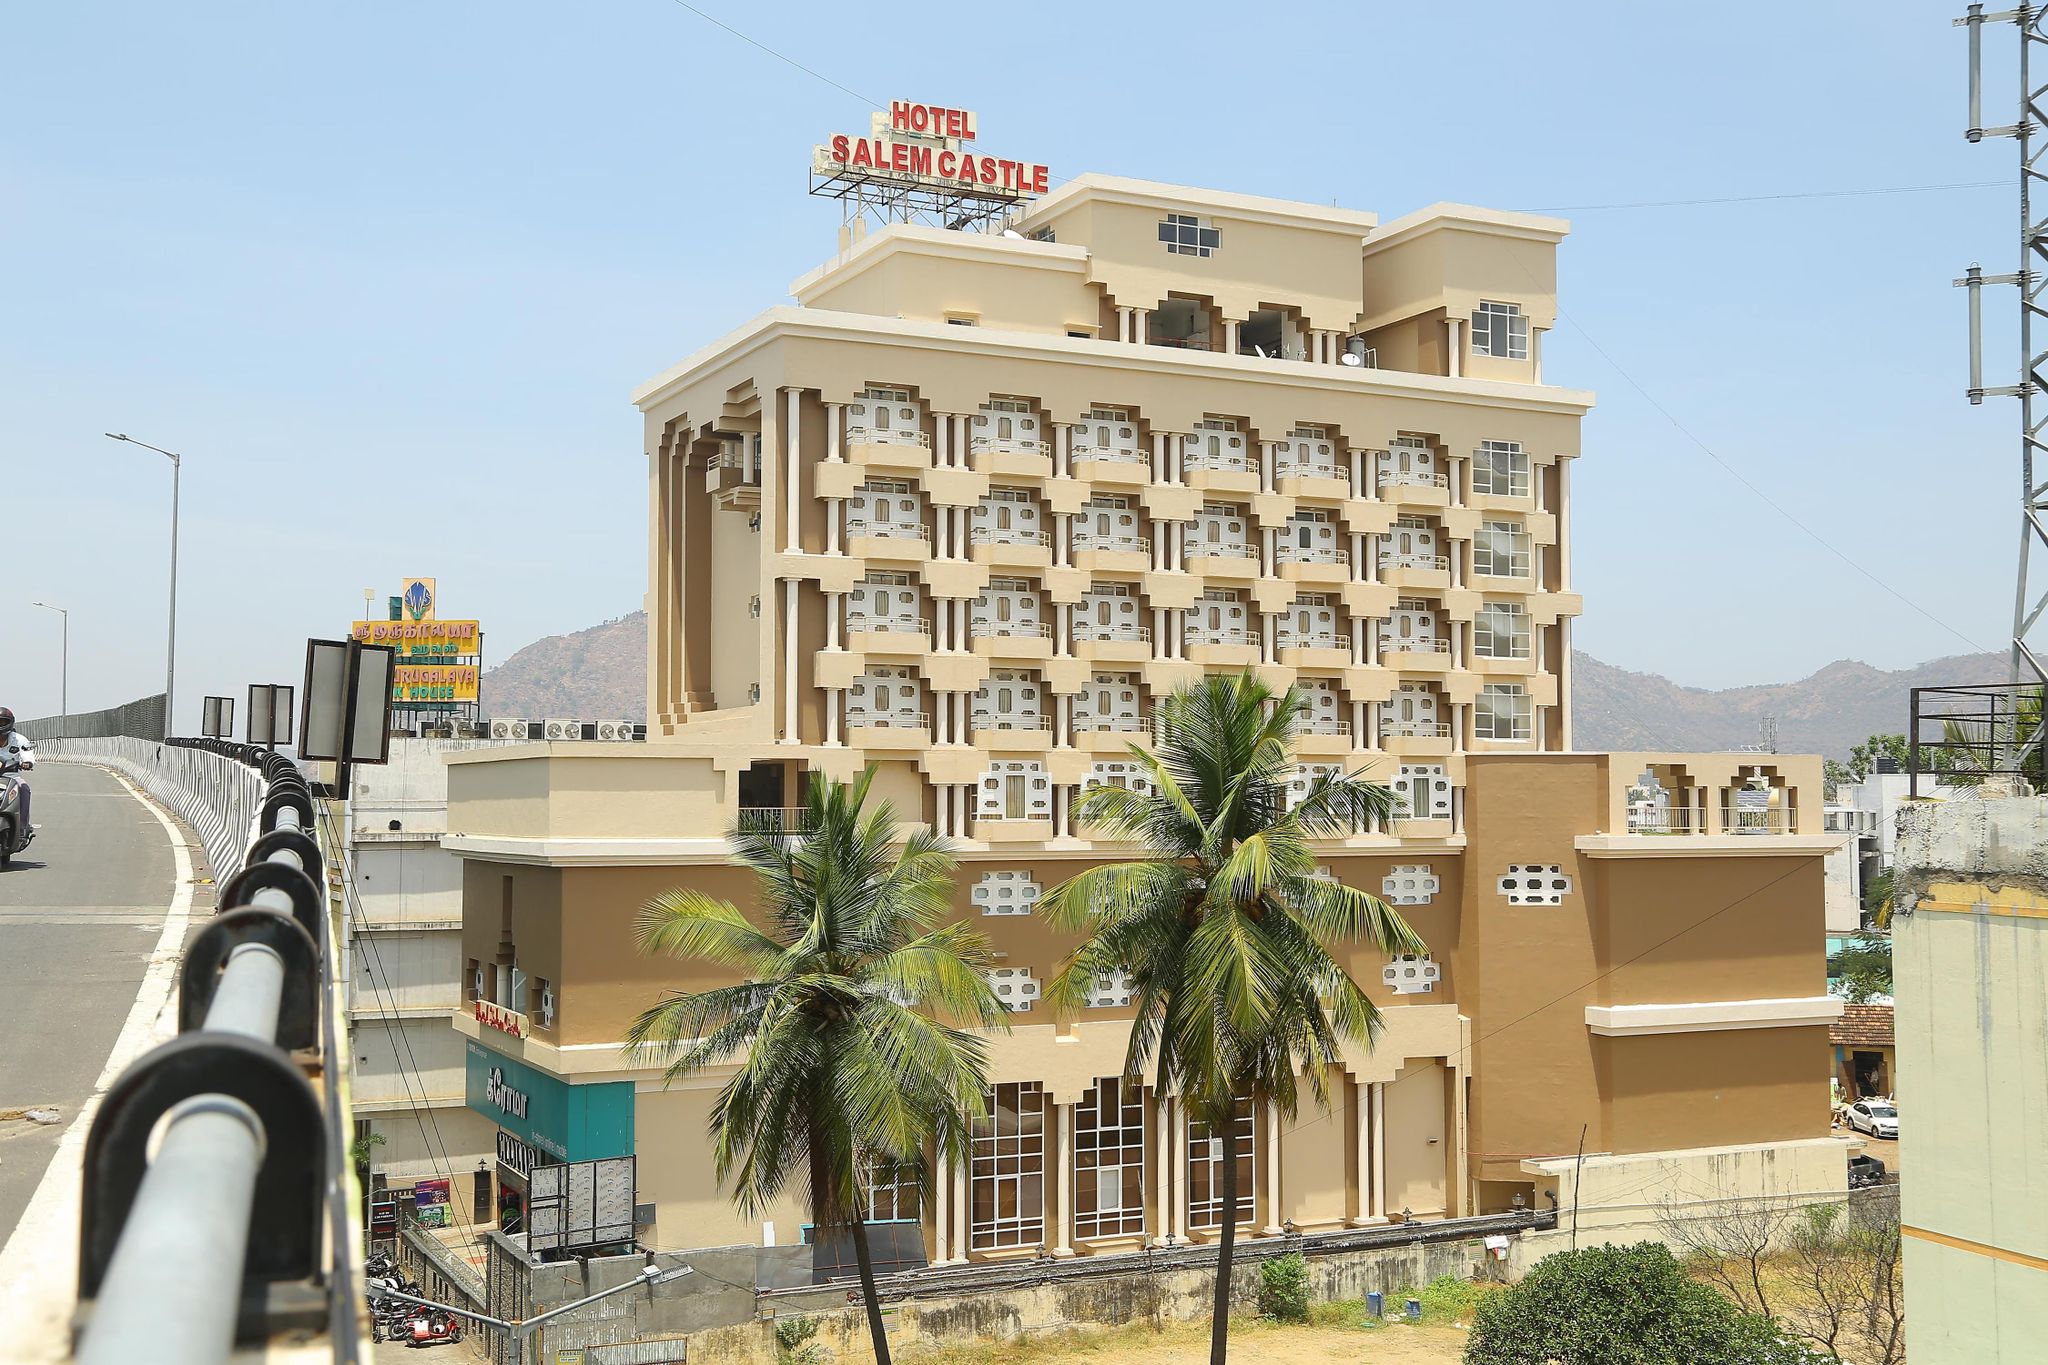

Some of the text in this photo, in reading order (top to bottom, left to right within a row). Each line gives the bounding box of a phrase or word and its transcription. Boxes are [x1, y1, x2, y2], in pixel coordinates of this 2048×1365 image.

[892, 101, 976, 140] HOTEL
[831, 135, 1049, 193] SALEM CASTLE
[394, 668, 475, 684] URUGALAYA
[410, 686, 455, 699] HOUSE
